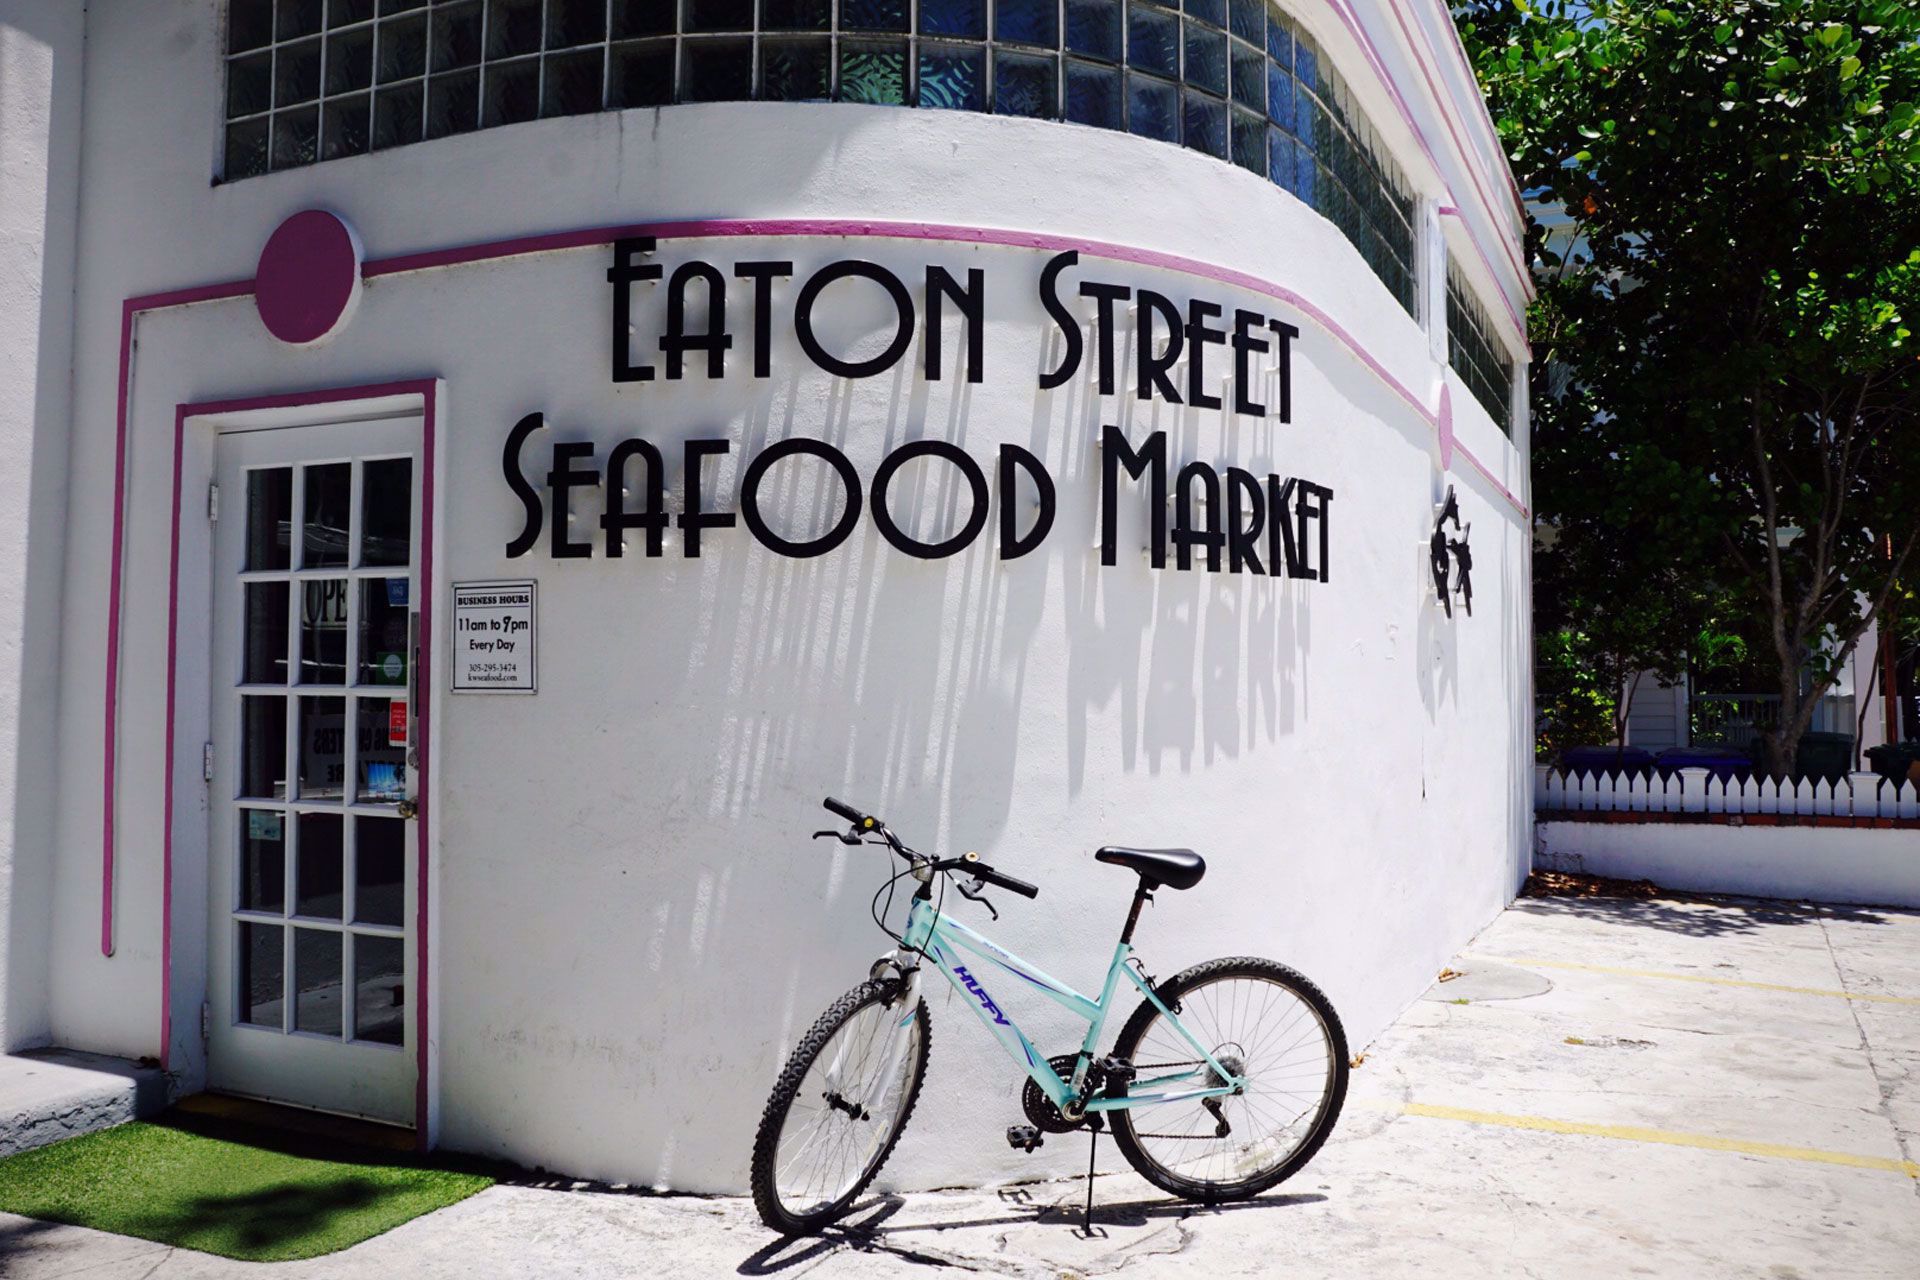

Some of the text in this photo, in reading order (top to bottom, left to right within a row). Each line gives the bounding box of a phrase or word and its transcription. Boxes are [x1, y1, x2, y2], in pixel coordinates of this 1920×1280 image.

[607, 237, 1299, 424] EATON STREET
[503, 412, 1333, 583] SEAFOOD MARKET
[306, 580, 347, 623] OPE
[457, 594, 530, 606] BUSINESS HOURS
[458, 618, 488, 631] 11am
[490, 619, 501, 631] to
[469, 638, 515, 653] Every Day
[468, 663, 517, 672] 305-295-3474
[953, 966, 1011, 1025] HUFFY
